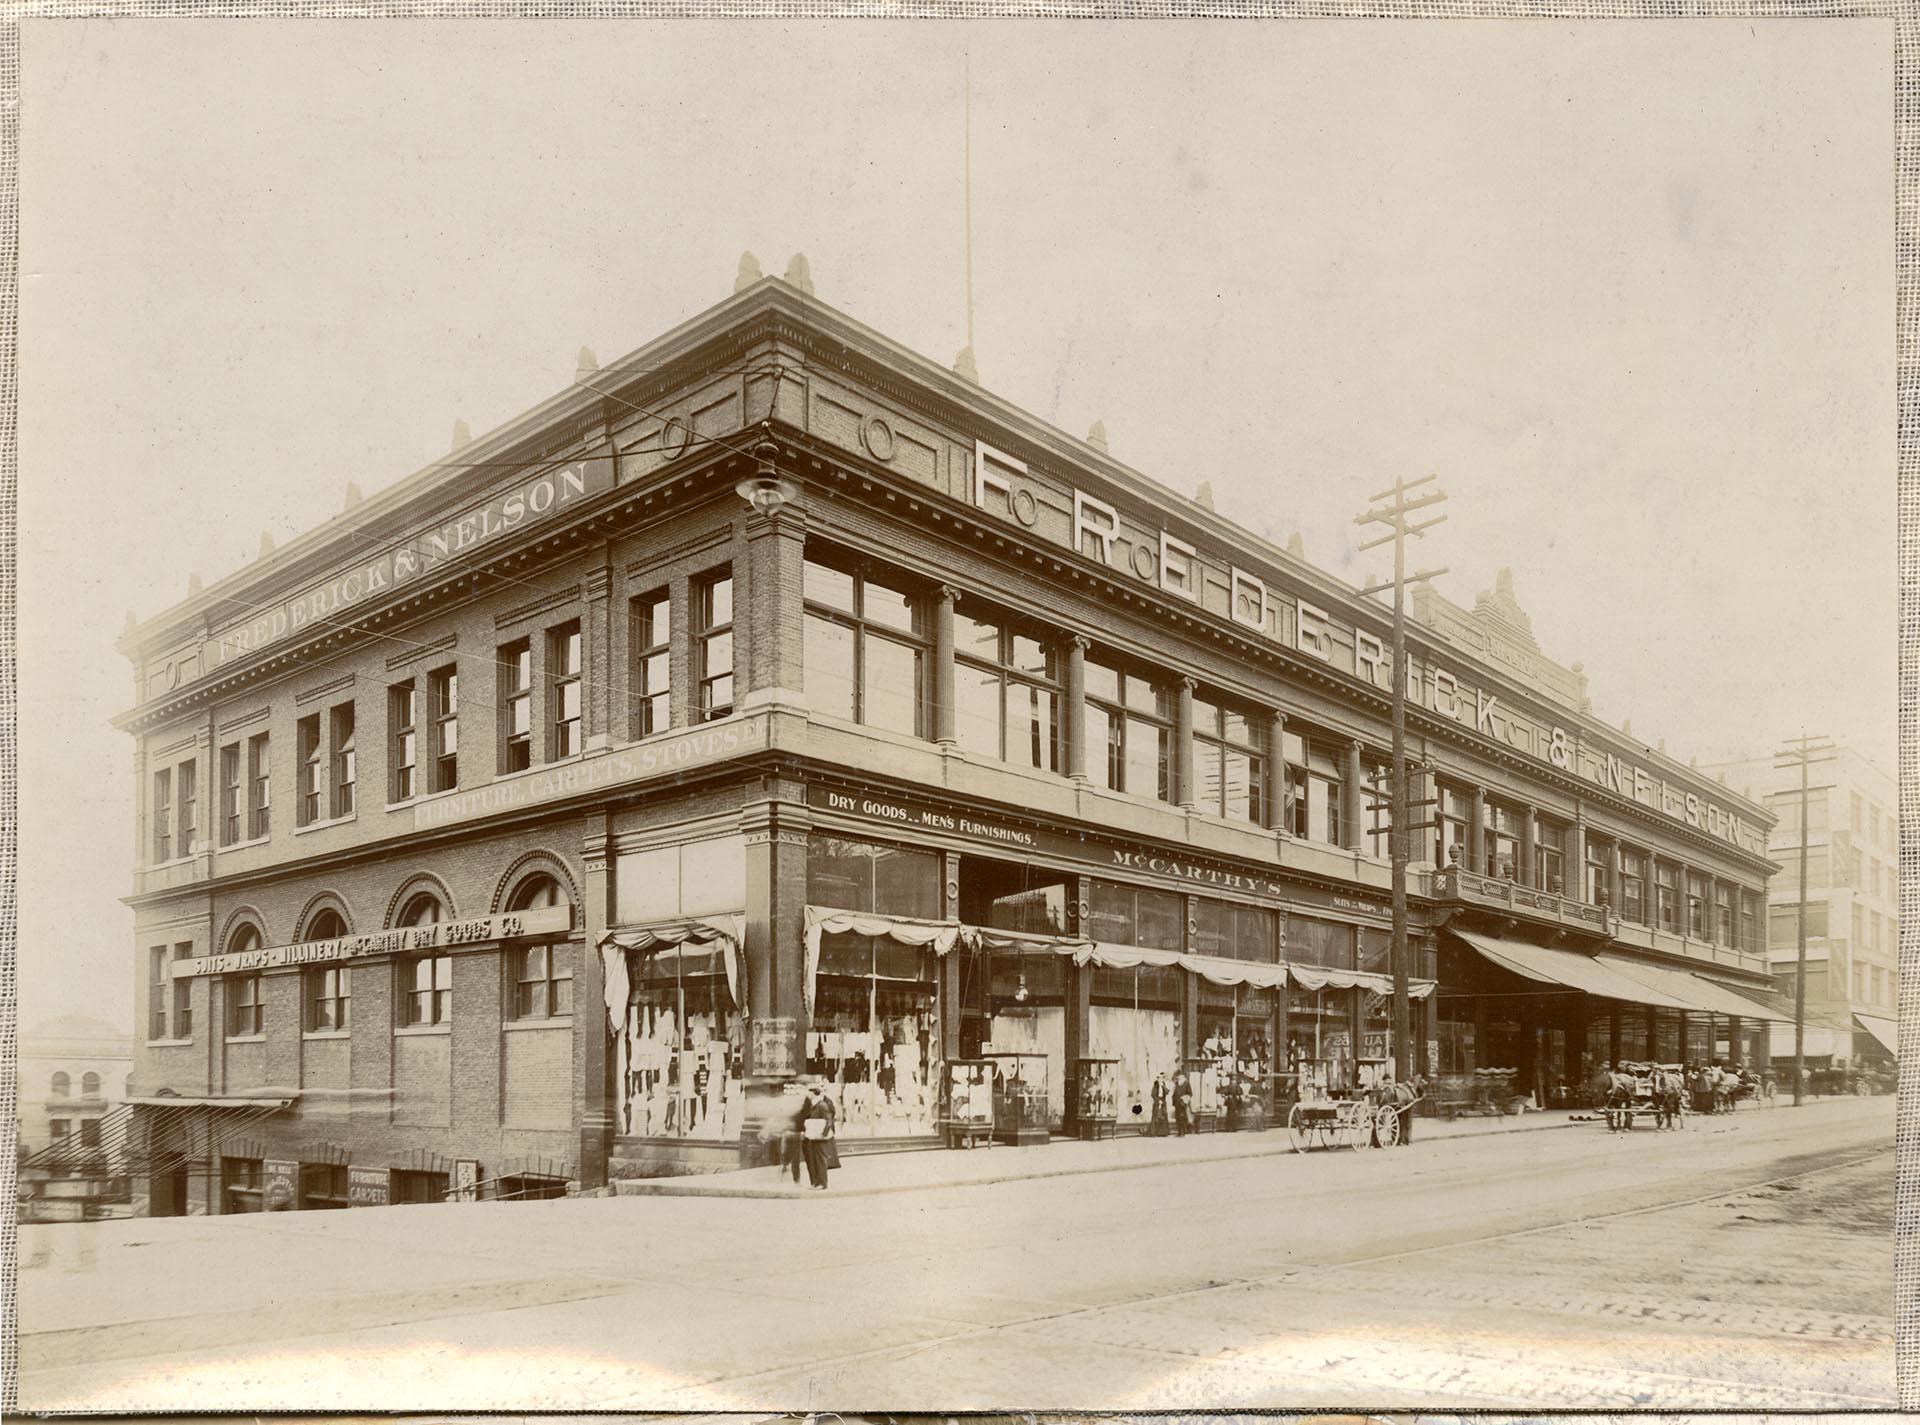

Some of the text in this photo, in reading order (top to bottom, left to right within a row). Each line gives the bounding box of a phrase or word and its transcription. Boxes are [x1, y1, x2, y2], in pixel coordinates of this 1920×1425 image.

[215, 461, 589, 663] FREDERICK & NELSON
[974, 438, 1498, 738] FREDERICK
[1548, 726, 1567, 770] &
[828, 793, 856, 811] DRY
[922, 812, 954, 829] MEN'S
[195, 957, 225, 975] SUITS
[445, 919, 491, 943] GOODS
